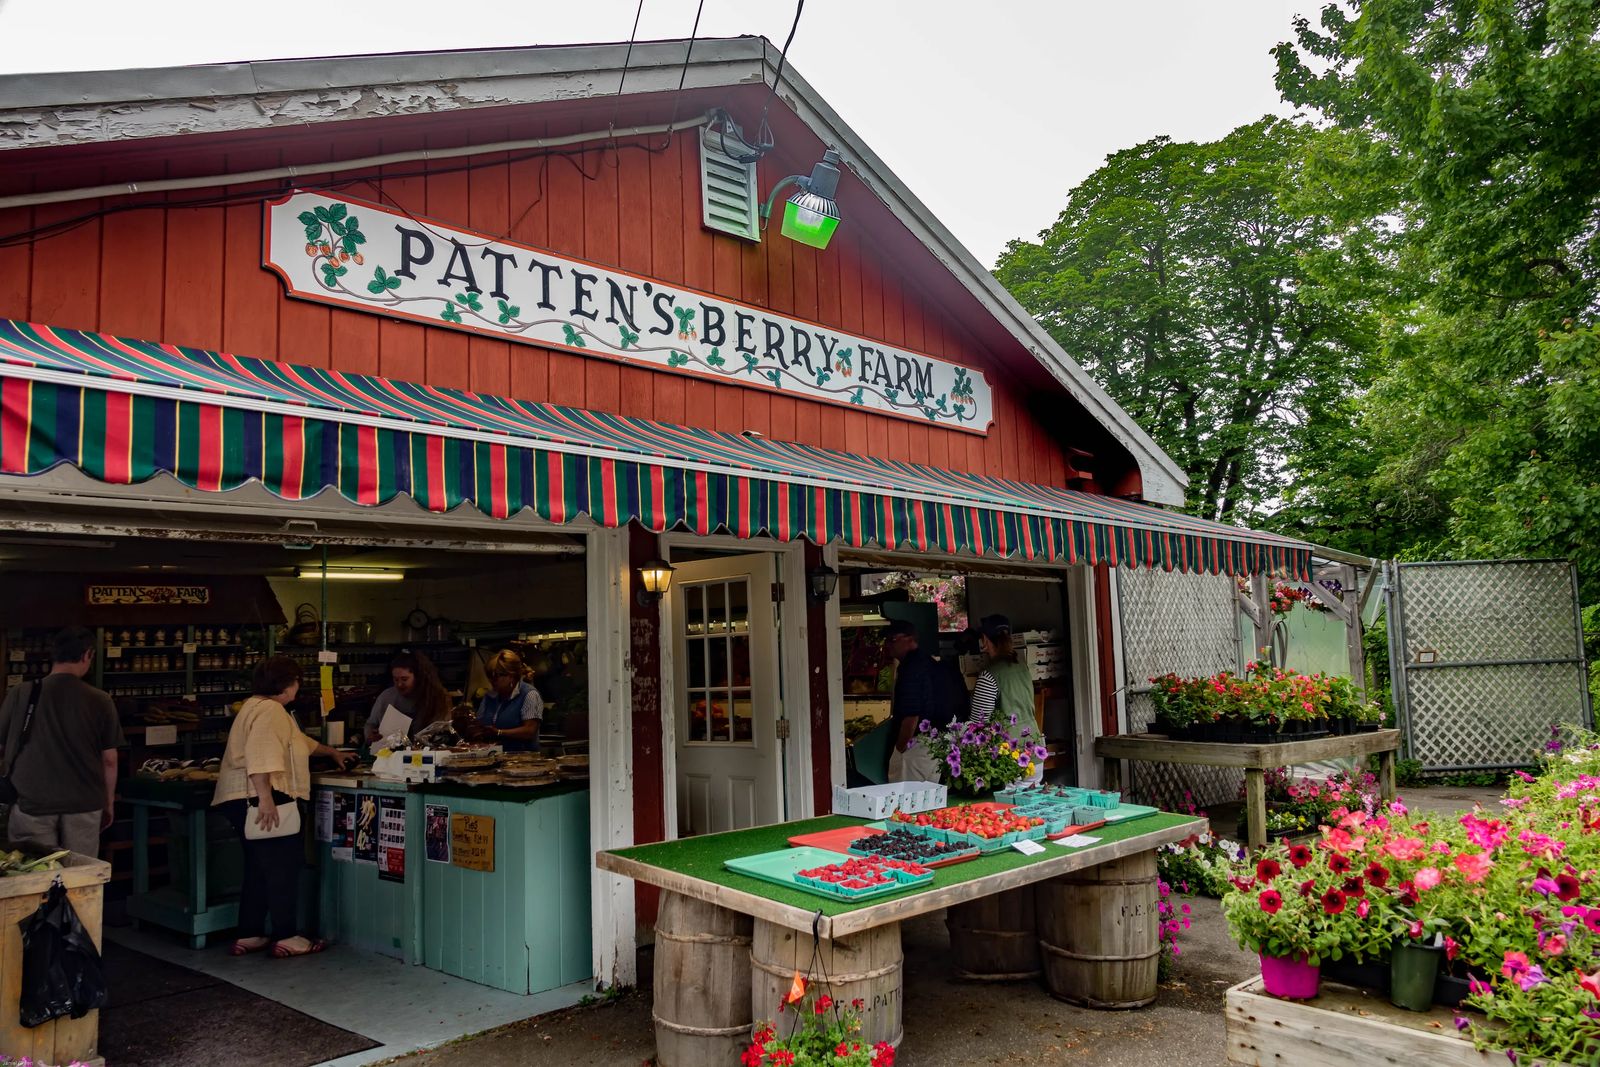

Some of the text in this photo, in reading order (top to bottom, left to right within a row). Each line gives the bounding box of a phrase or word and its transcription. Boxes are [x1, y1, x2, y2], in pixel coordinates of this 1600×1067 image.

[394, 224, 935, 400] PATTEN'S BERRY FARM
[92, 586, 146, 599] PATTEN'S
[176, 587, 207, 599] FARM
